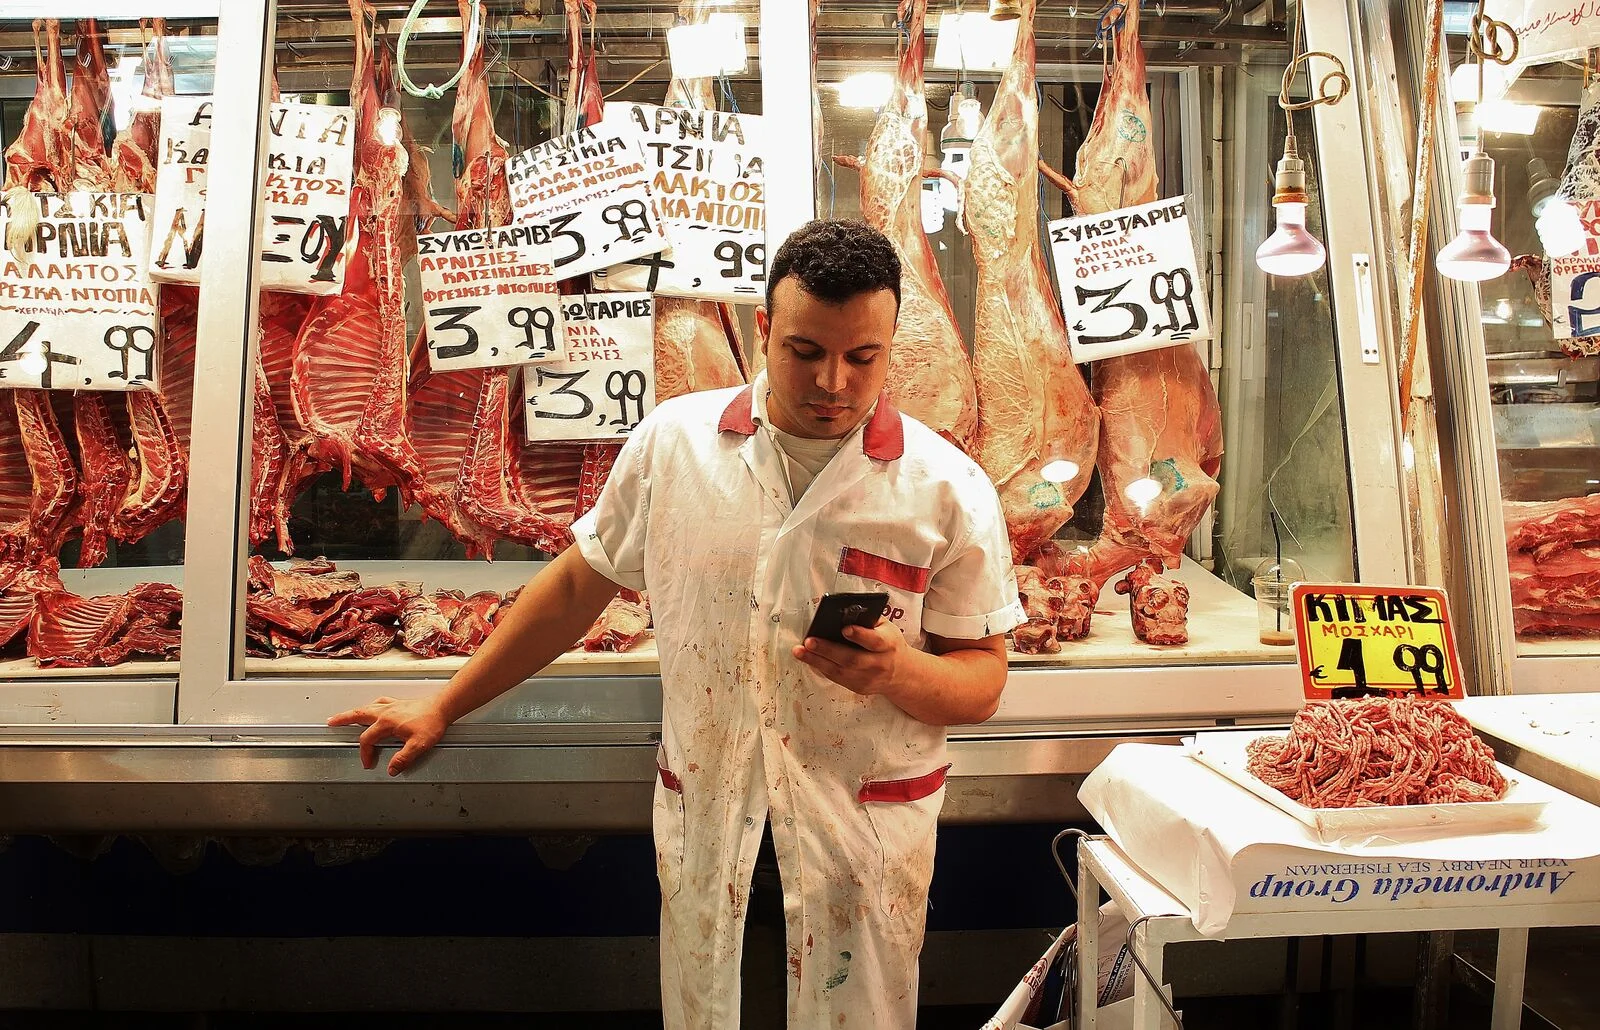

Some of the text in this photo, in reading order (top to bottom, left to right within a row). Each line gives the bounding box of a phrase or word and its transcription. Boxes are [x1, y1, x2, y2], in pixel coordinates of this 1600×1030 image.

[508, 137, 627, 185] ΚΑΤΣΙΚΙΑ
[511, 127, 597, 171] ΑΡΝΙΑ
[514, 156, 619, 195] ΓΑΛΑΚΤΟΣ
[418, 224, 553, 255] ΣΥΚΩΤΑΡΙΕΣ
[1080, 236, 1129, 255] ΑΡΝΙΑ
[1073, 244, 1146, 266] ΚΑΤΣΙΚΙΑ
[1075, 252, 1158, 279] ΦΡΕΣΚΕΣ
[1304, 592, 1447, 624] ΚΙΜΑΣ
[1321, 624, 1414, 640] ΜΟΣΧΑΡΙ
[1285, 863, 1393, 876] FISHERMAN
[1401, 861, 1432, 873] SEA
[1440, 859, 1514, 872] NEARBY
[1249, 870, 1576, 904] Andromeda Group
